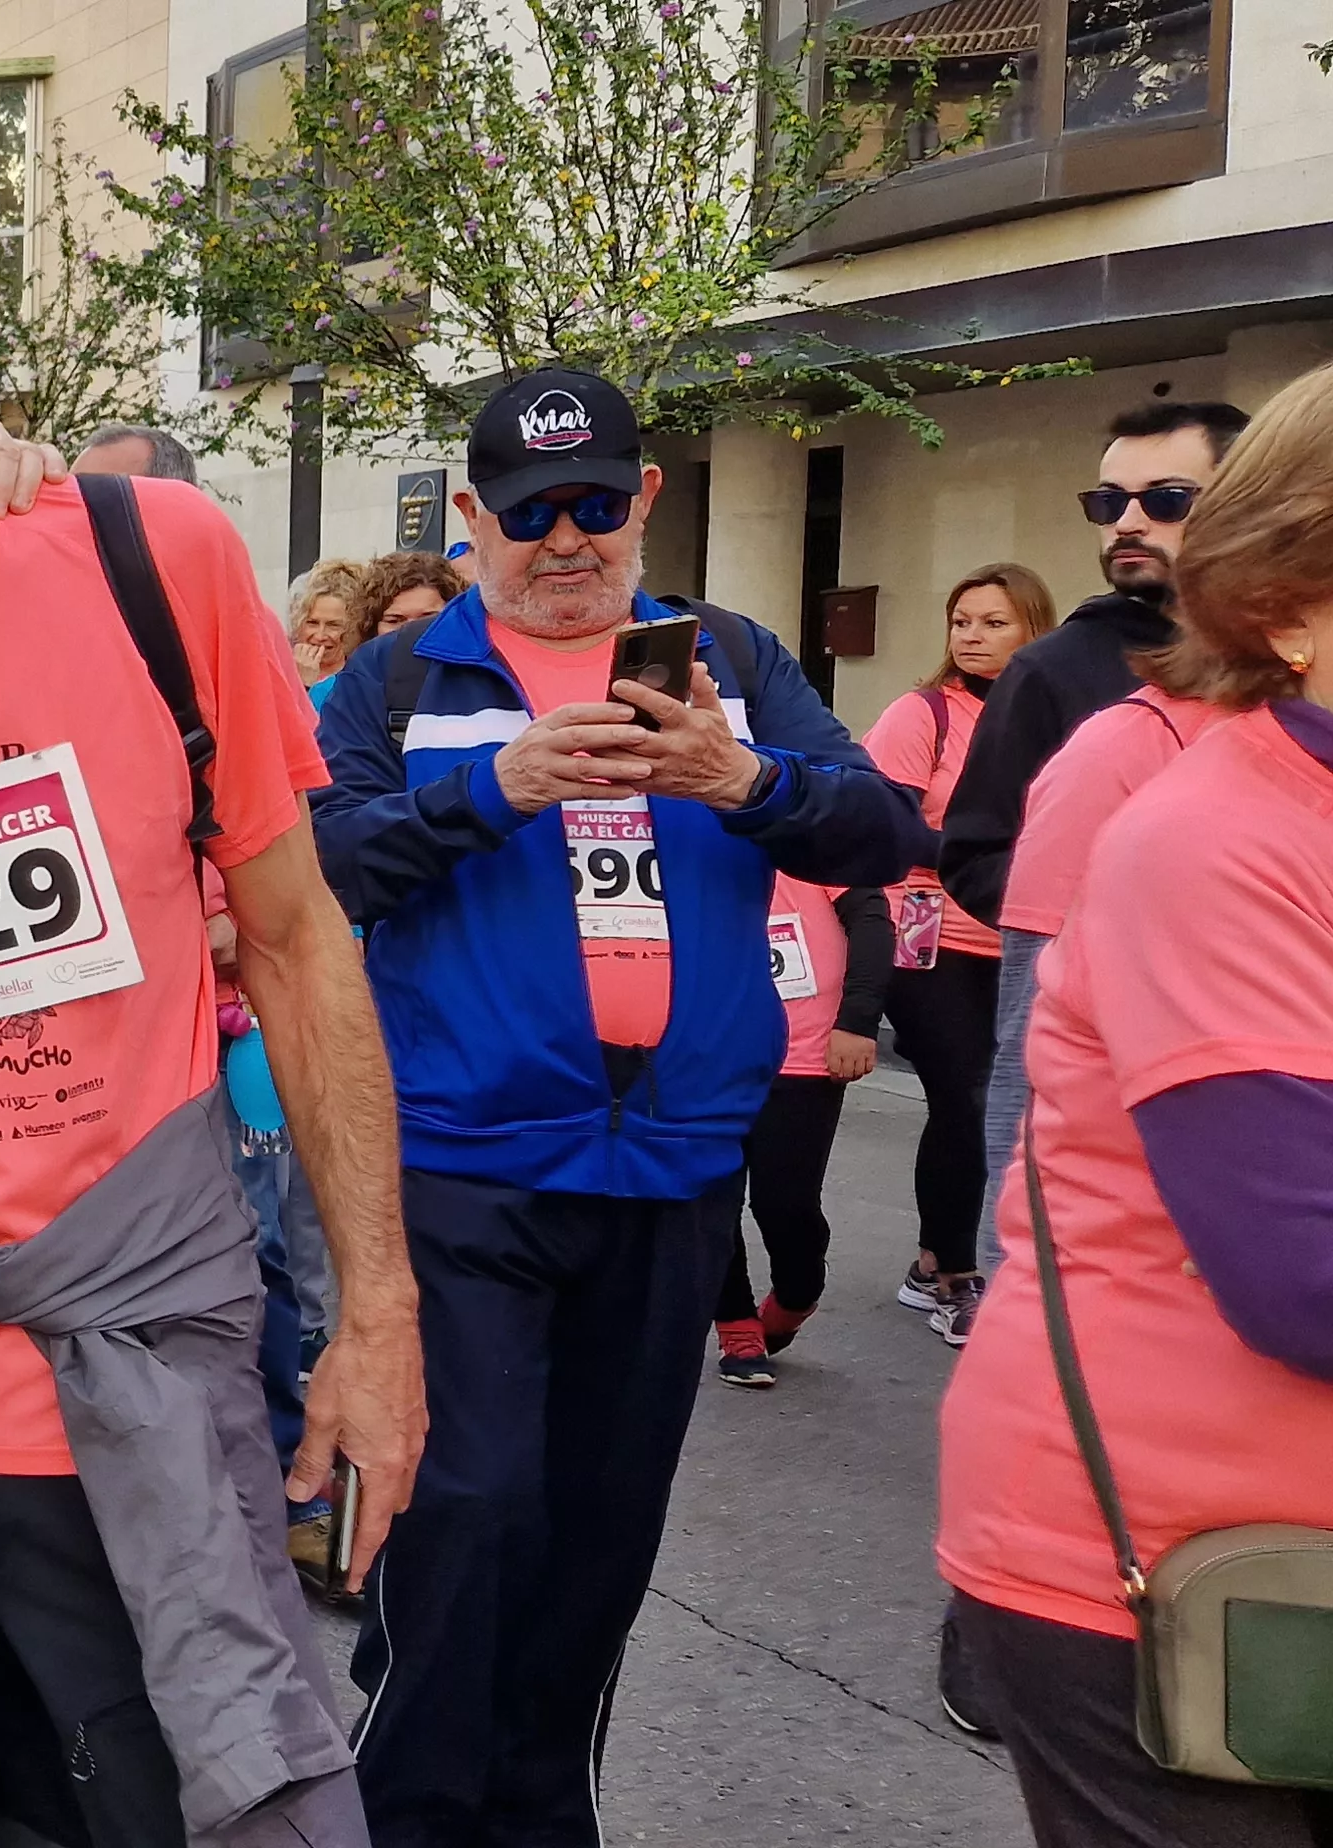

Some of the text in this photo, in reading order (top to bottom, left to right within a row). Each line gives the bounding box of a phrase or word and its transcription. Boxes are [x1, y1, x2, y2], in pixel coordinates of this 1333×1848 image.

[518, 408, 592, 440] Kviar
[578, 814, 631, 824] HUESCA
[598, 825, 617, 838] EL
[772, 931, 792, 941] CER
